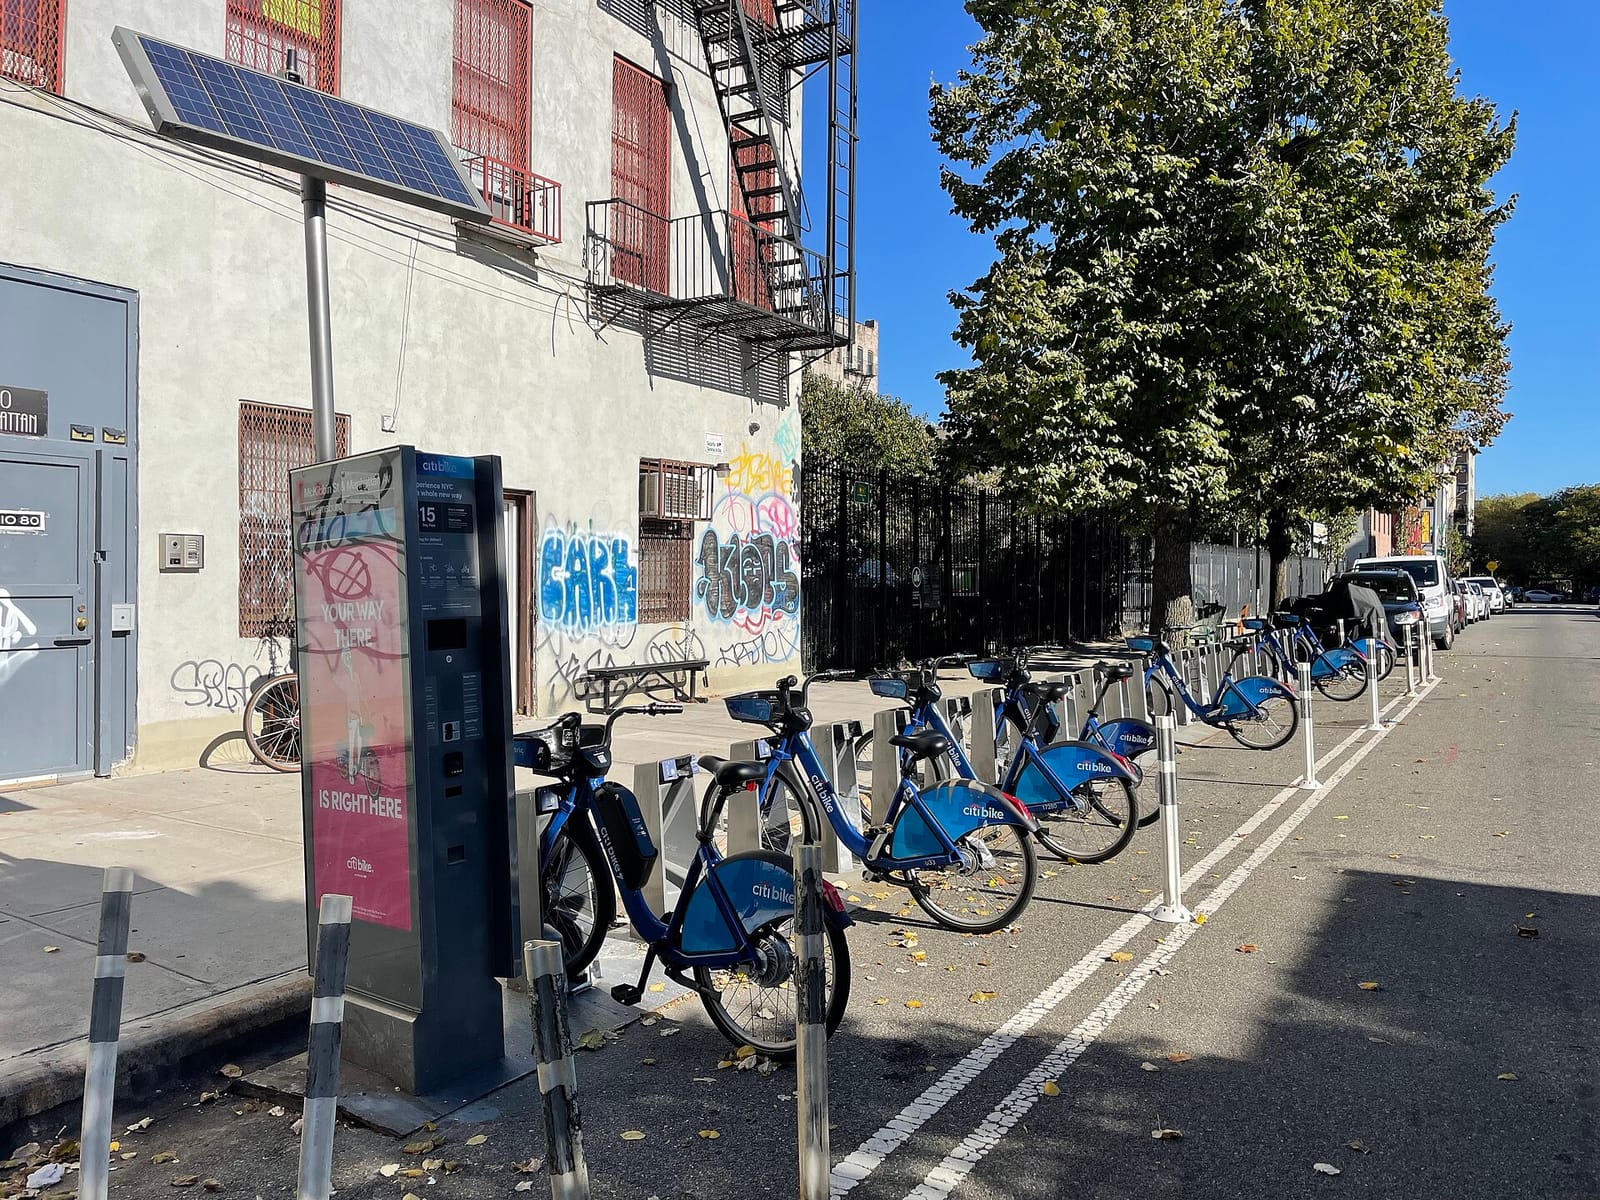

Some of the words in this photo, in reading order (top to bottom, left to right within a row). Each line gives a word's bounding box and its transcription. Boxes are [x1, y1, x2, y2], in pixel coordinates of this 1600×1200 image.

[320, 603, 354, 622] YOUR
[356, 600, 384, 621] WAY
[334, 627, 373, 648] THERE
[319, 789, 329, 808] IS
[332, 791, 368, 813] RIGHT
[369, 796, 402, 819] HERE
